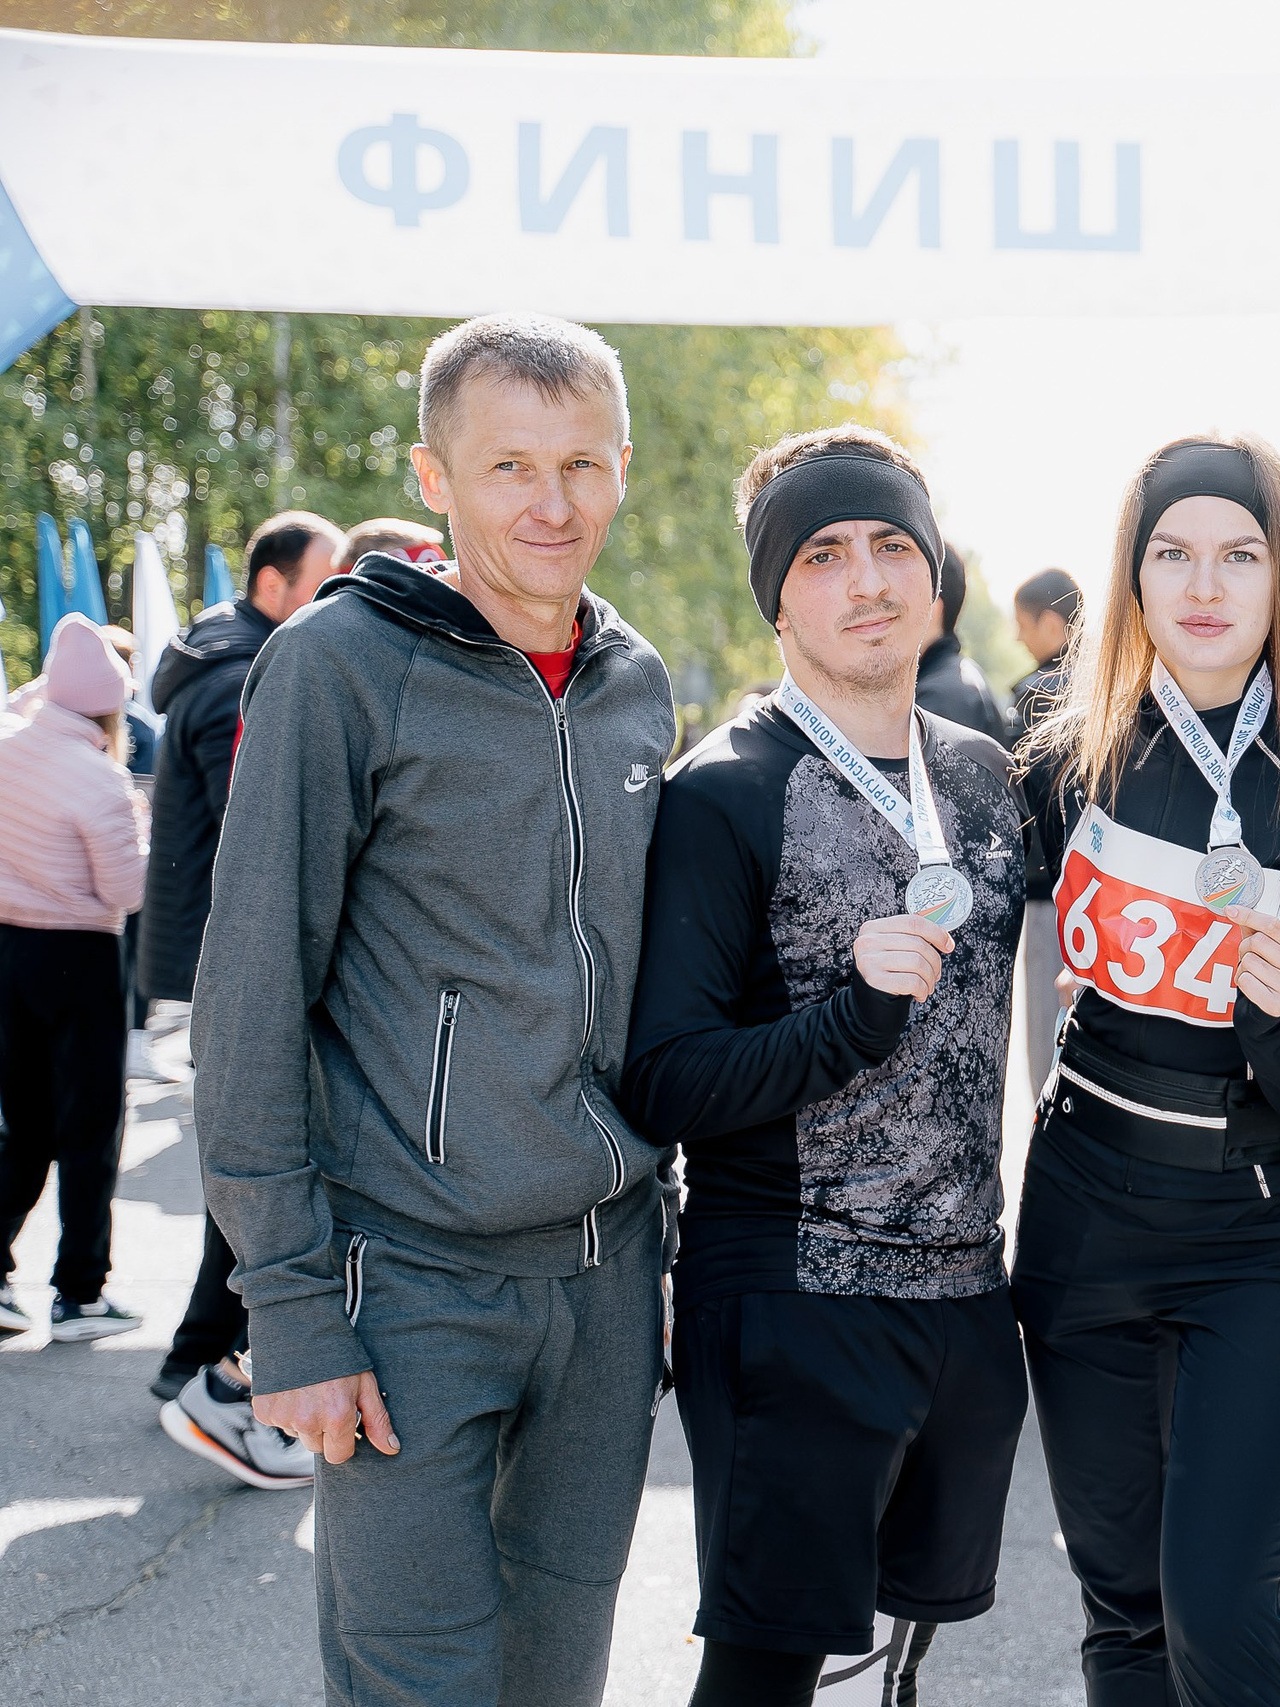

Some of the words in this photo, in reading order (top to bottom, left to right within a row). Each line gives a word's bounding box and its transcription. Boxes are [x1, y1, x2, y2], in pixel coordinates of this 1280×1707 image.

[336, 112, 1143, 253] ФИНИШ
[1159, 684, 1180, 711] 2025
[1242, 686, 1265, 726] КОЛЬЦО
[793, 702, 837, 749] КОЛЬЦО
[1180, 719, 1213, 762] КОЛЬЦО
[630, 763, 649, 781] NIKE
[833, 745, 897, 812] СУРГУТСКОЕ
[986, 850, 1012, 859] DEMIX
[1063, 877, 1238, 1014] 634
